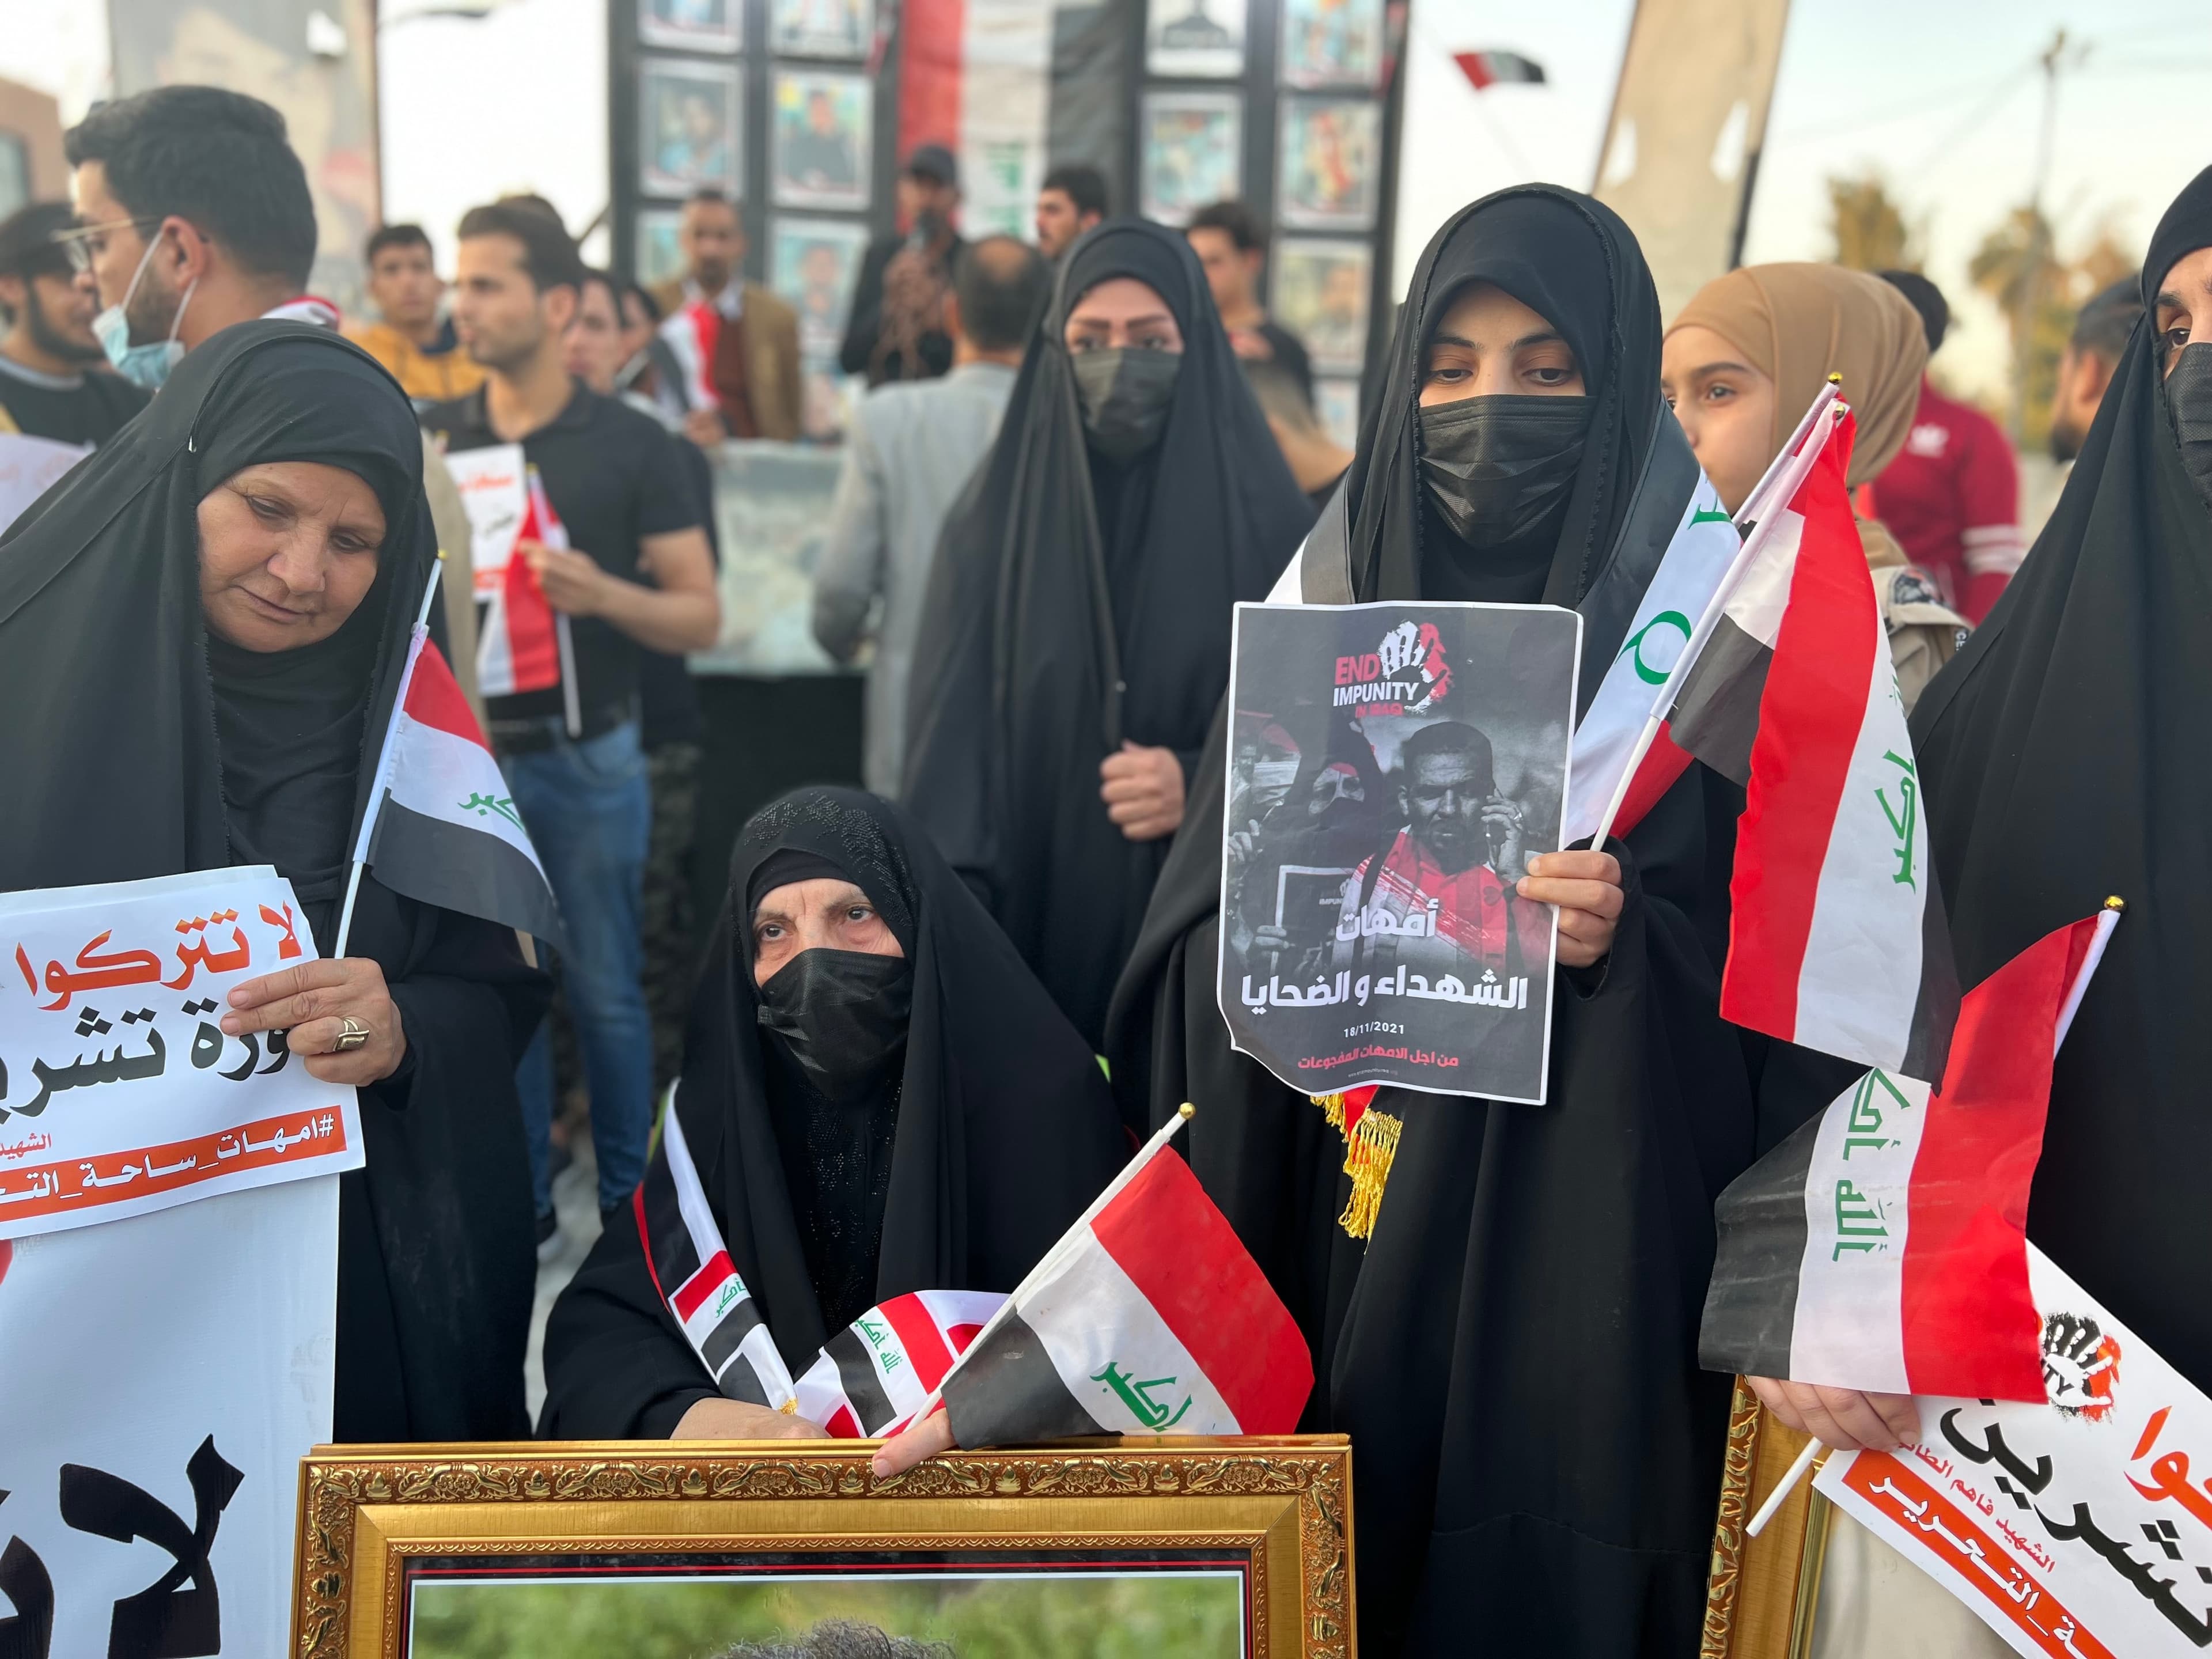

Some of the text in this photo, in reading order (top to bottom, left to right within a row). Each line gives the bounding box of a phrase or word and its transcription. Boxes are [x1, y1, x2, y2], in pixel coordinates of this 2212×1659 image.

[1335, 654, 1380, 685] END
[1333, 681, 1419, 707] IMPUNITY
[457, 792, 526, 834] كبر
[1336, 899, 1438, 941] أمهات
[15, 900, 302, 1011] لا تتركوا
[1373, 965, 1528, 1010] الشهداء
[181, 997, 290, 1081] ورة
[1344, 1021, 1404, 1037] 18/11/2021
[1410, 1050, 1435, 1066] اجل
[1437, 1054, 1459, 1067] من
[1950, 1479, 1994, 1516] فاهم
[1995, 1518, 2055, 1573] الشهيد
